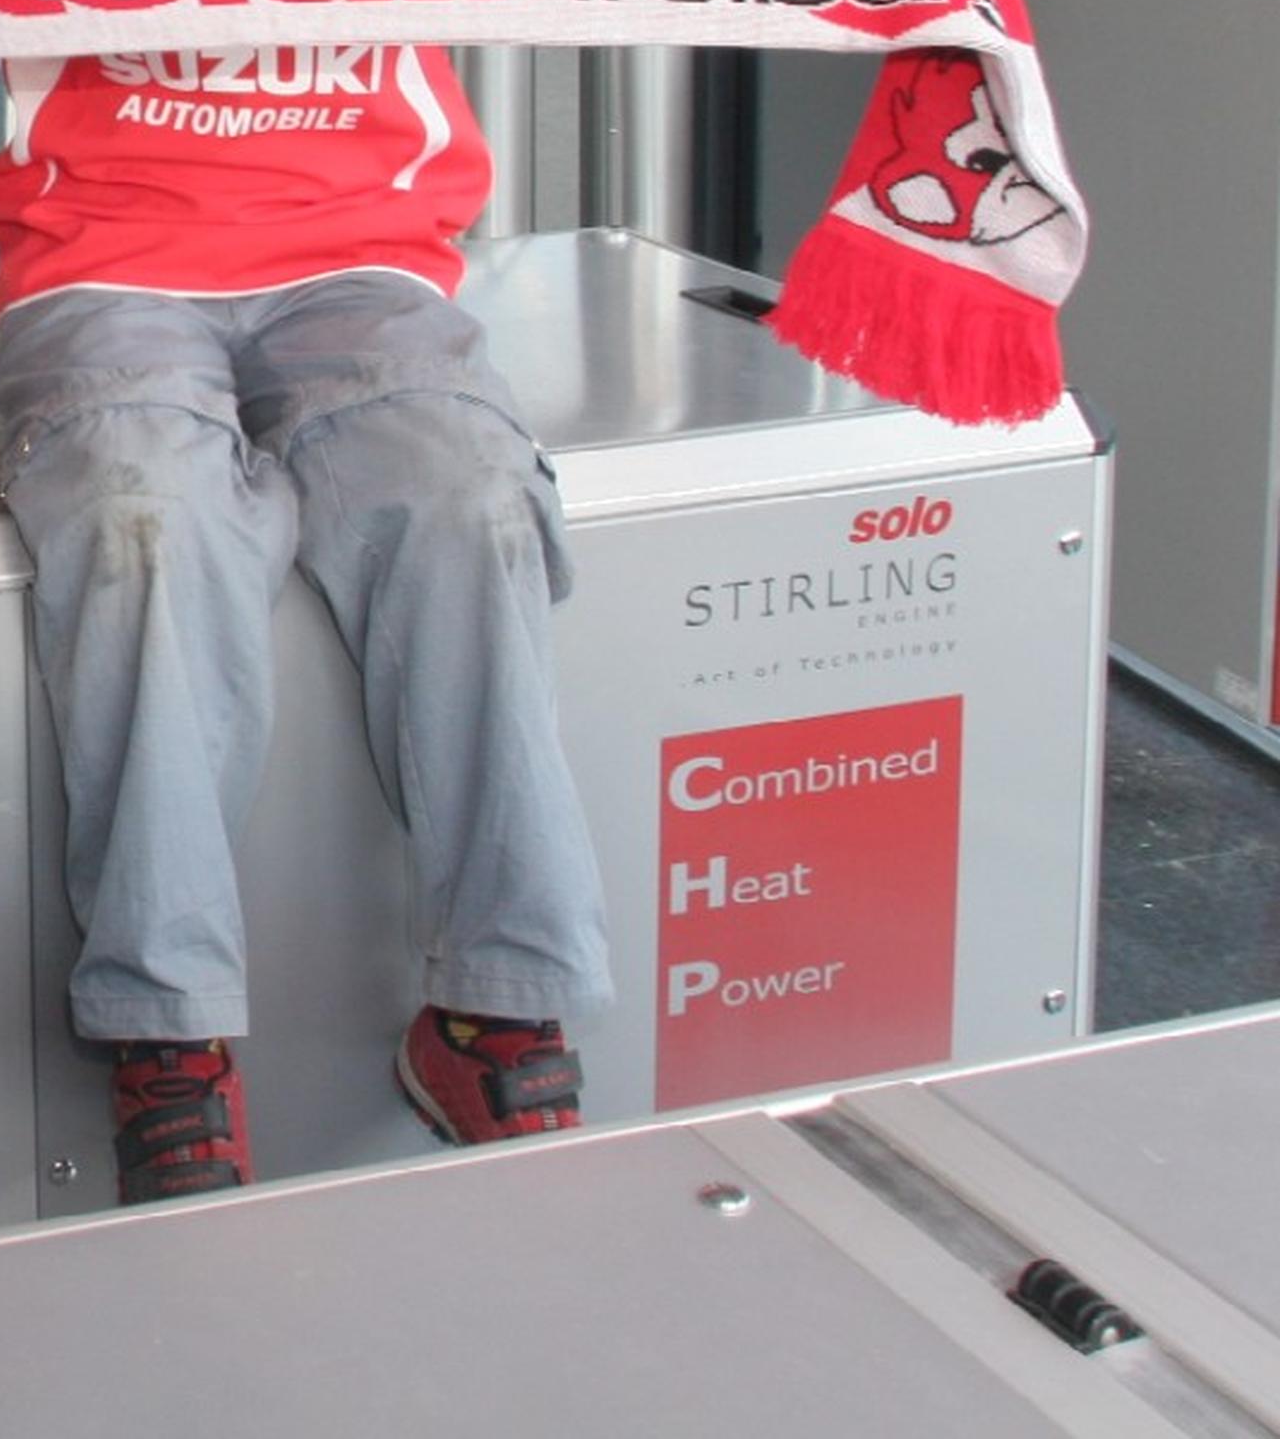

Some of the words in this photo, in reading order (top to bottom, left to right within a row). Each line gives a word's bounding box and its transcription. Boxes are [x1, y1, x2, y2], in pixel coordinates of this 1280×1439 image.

[116, 94, 364, 138] AUTOMOBILE
[849, 496, 952, 545] solo
[684, 552, 959, 627] STIRLING
[856, 602, 958, 629] ENGINE
[755, 661, 781, 679] of
[799, 638, 958, 672] Technology
[668, 739, 938, 812] Combined
[668, 855, 812, 915] Heat
[667, 959, 844, 1017] Power
